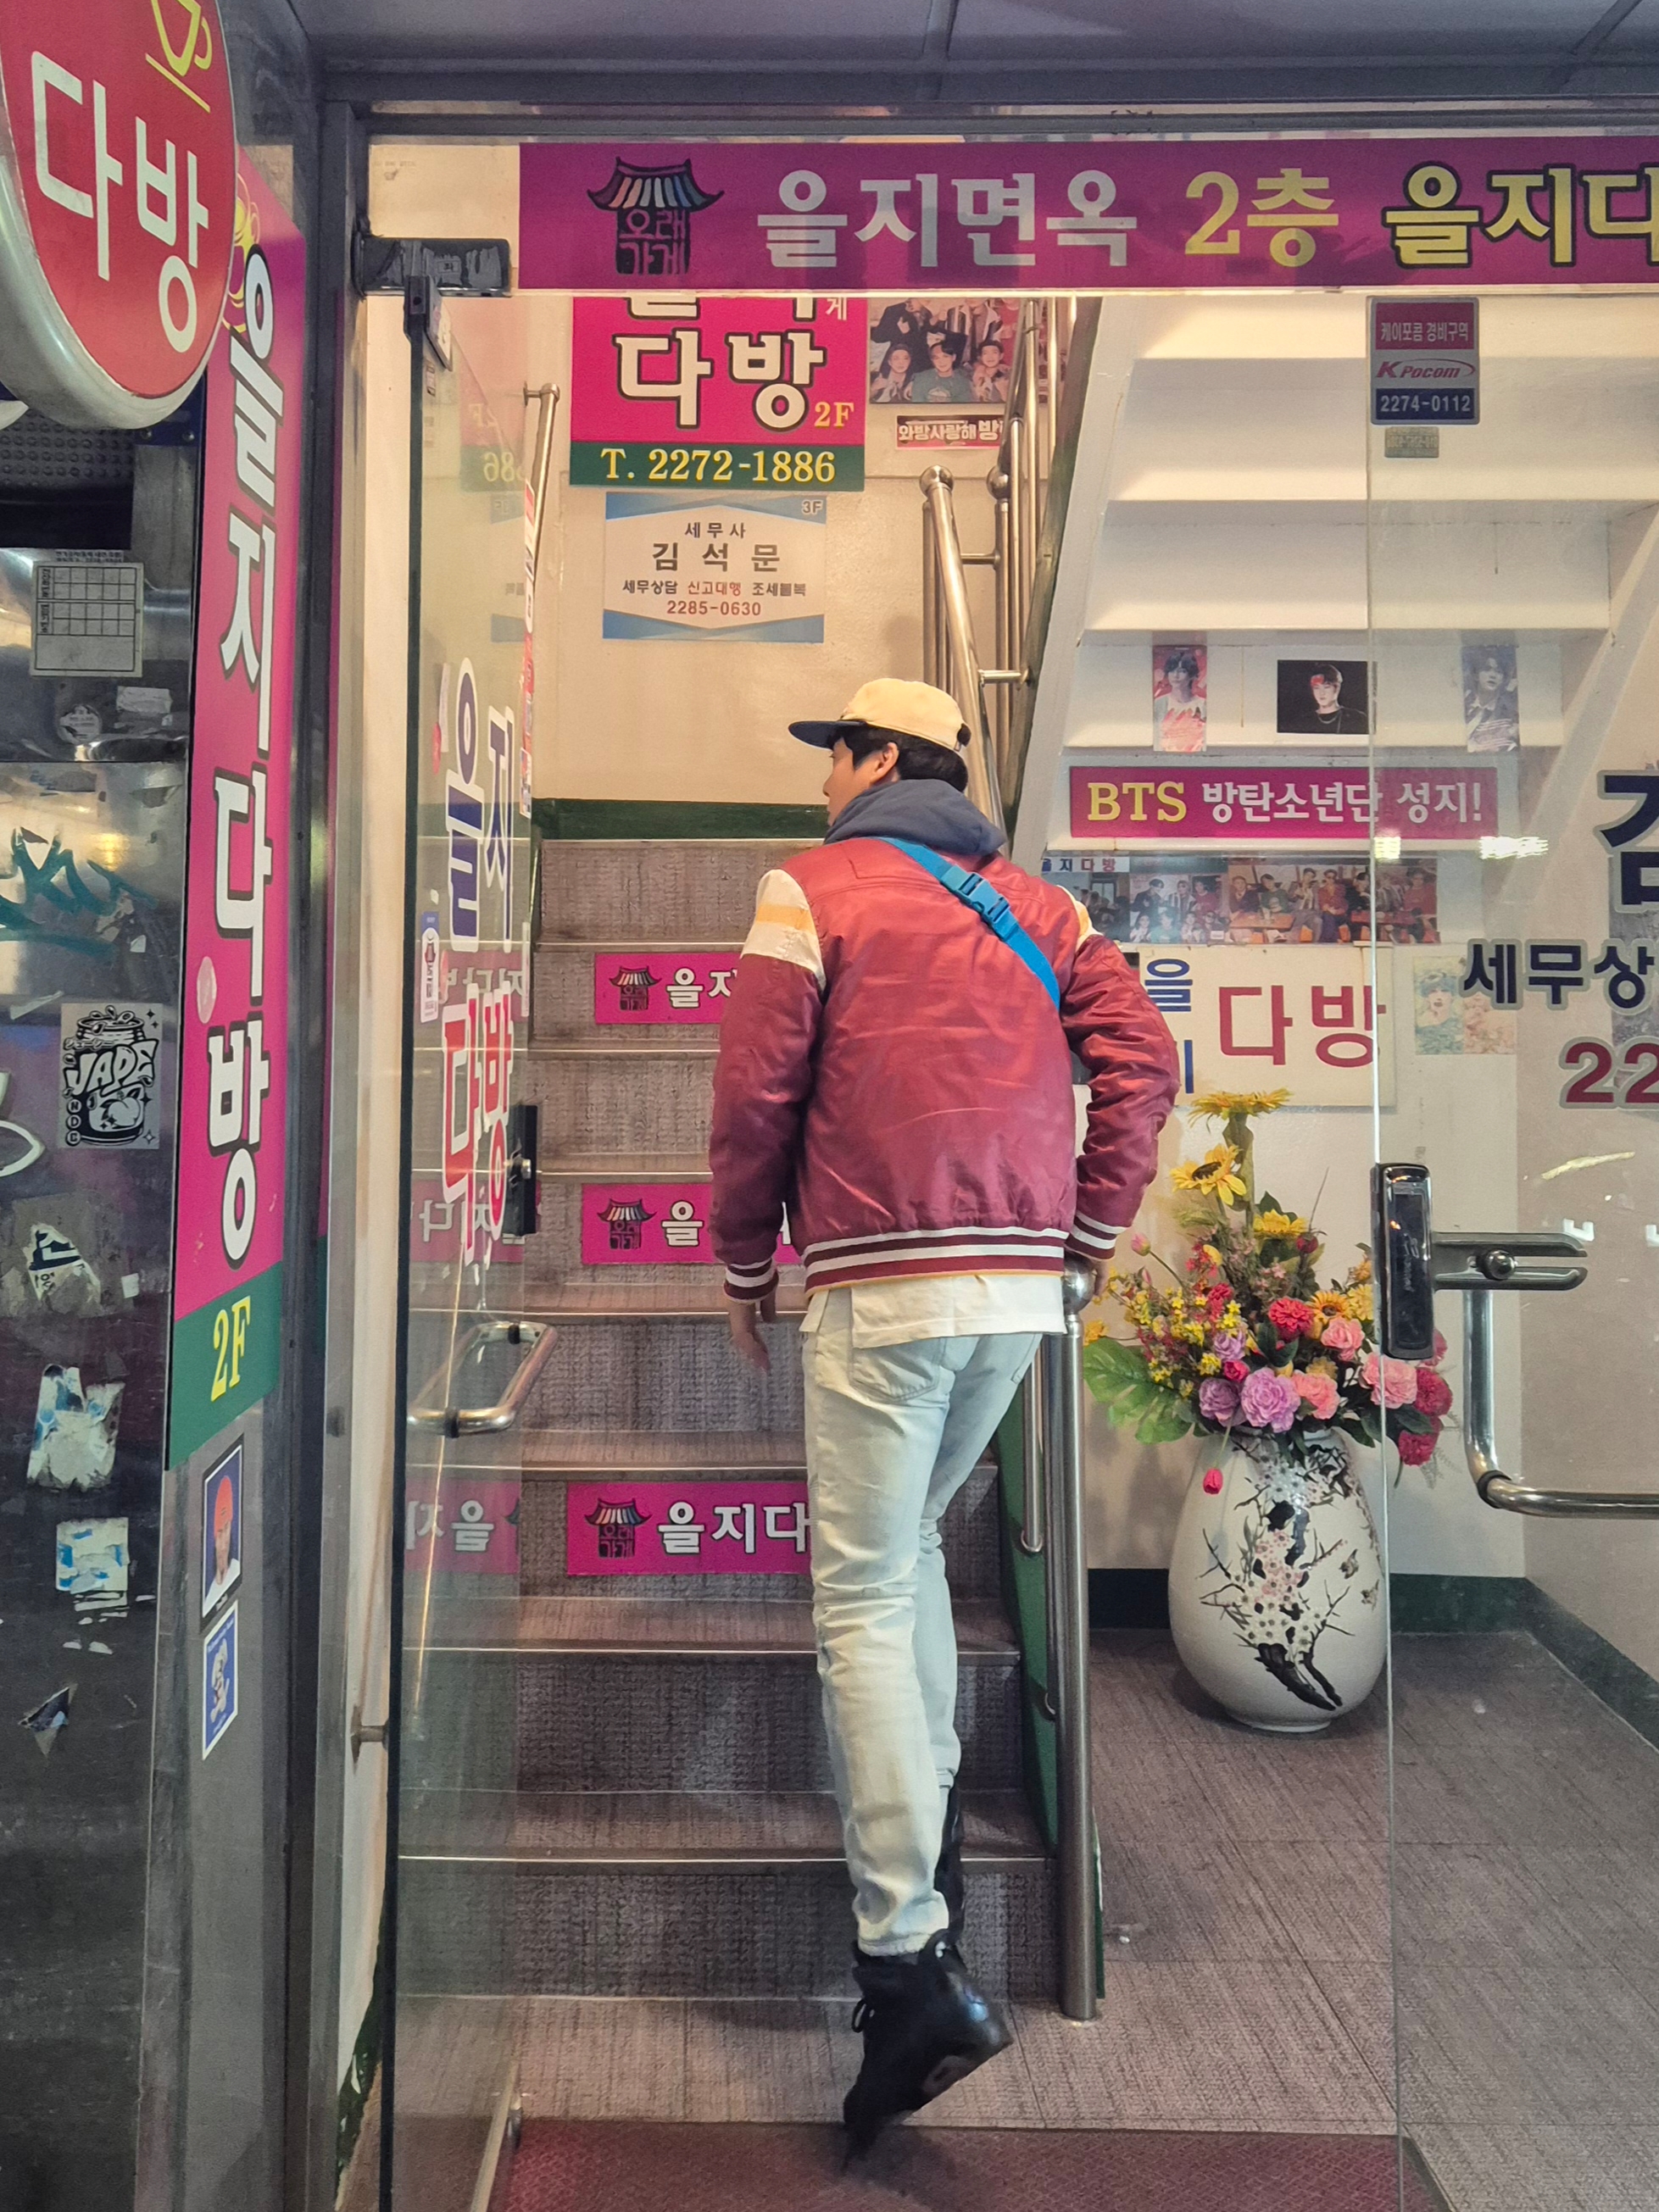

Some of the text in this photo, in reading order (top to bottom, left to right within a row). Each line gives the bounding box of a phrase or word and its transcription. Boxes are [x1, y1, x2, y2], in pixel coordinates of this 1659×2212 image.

[31, 51, 209, 353] 다방
[758, 170, 1137, 268] 을지면옥
[1185, 168, 1339, 268] 2층
[620, 209, 686, 239] 오래
[620, 242, 686, 275] 가게
[1427, 322, 1468, 342] 경비구역
[614, 329, 855, 430] 다방 2F
[1380, 395, 1471, 412] 2274-0112
[600, 448, 836, 483] T. 2272-1886
[802, 500, 823, 514] 3F
[622, 580, 678, 595] 세무상담
[688, 581, 742, 596] 신고대행
[666, 600, 761, 616] 2285-0630
[206, 251, 284, 1263] 을지다방
[1088, 781, 1483, 823] BTS 방탄소년단 성지!
[1219, 984, 1387, 1068] 다방
[211, 1295, 251, 1402] 2F
